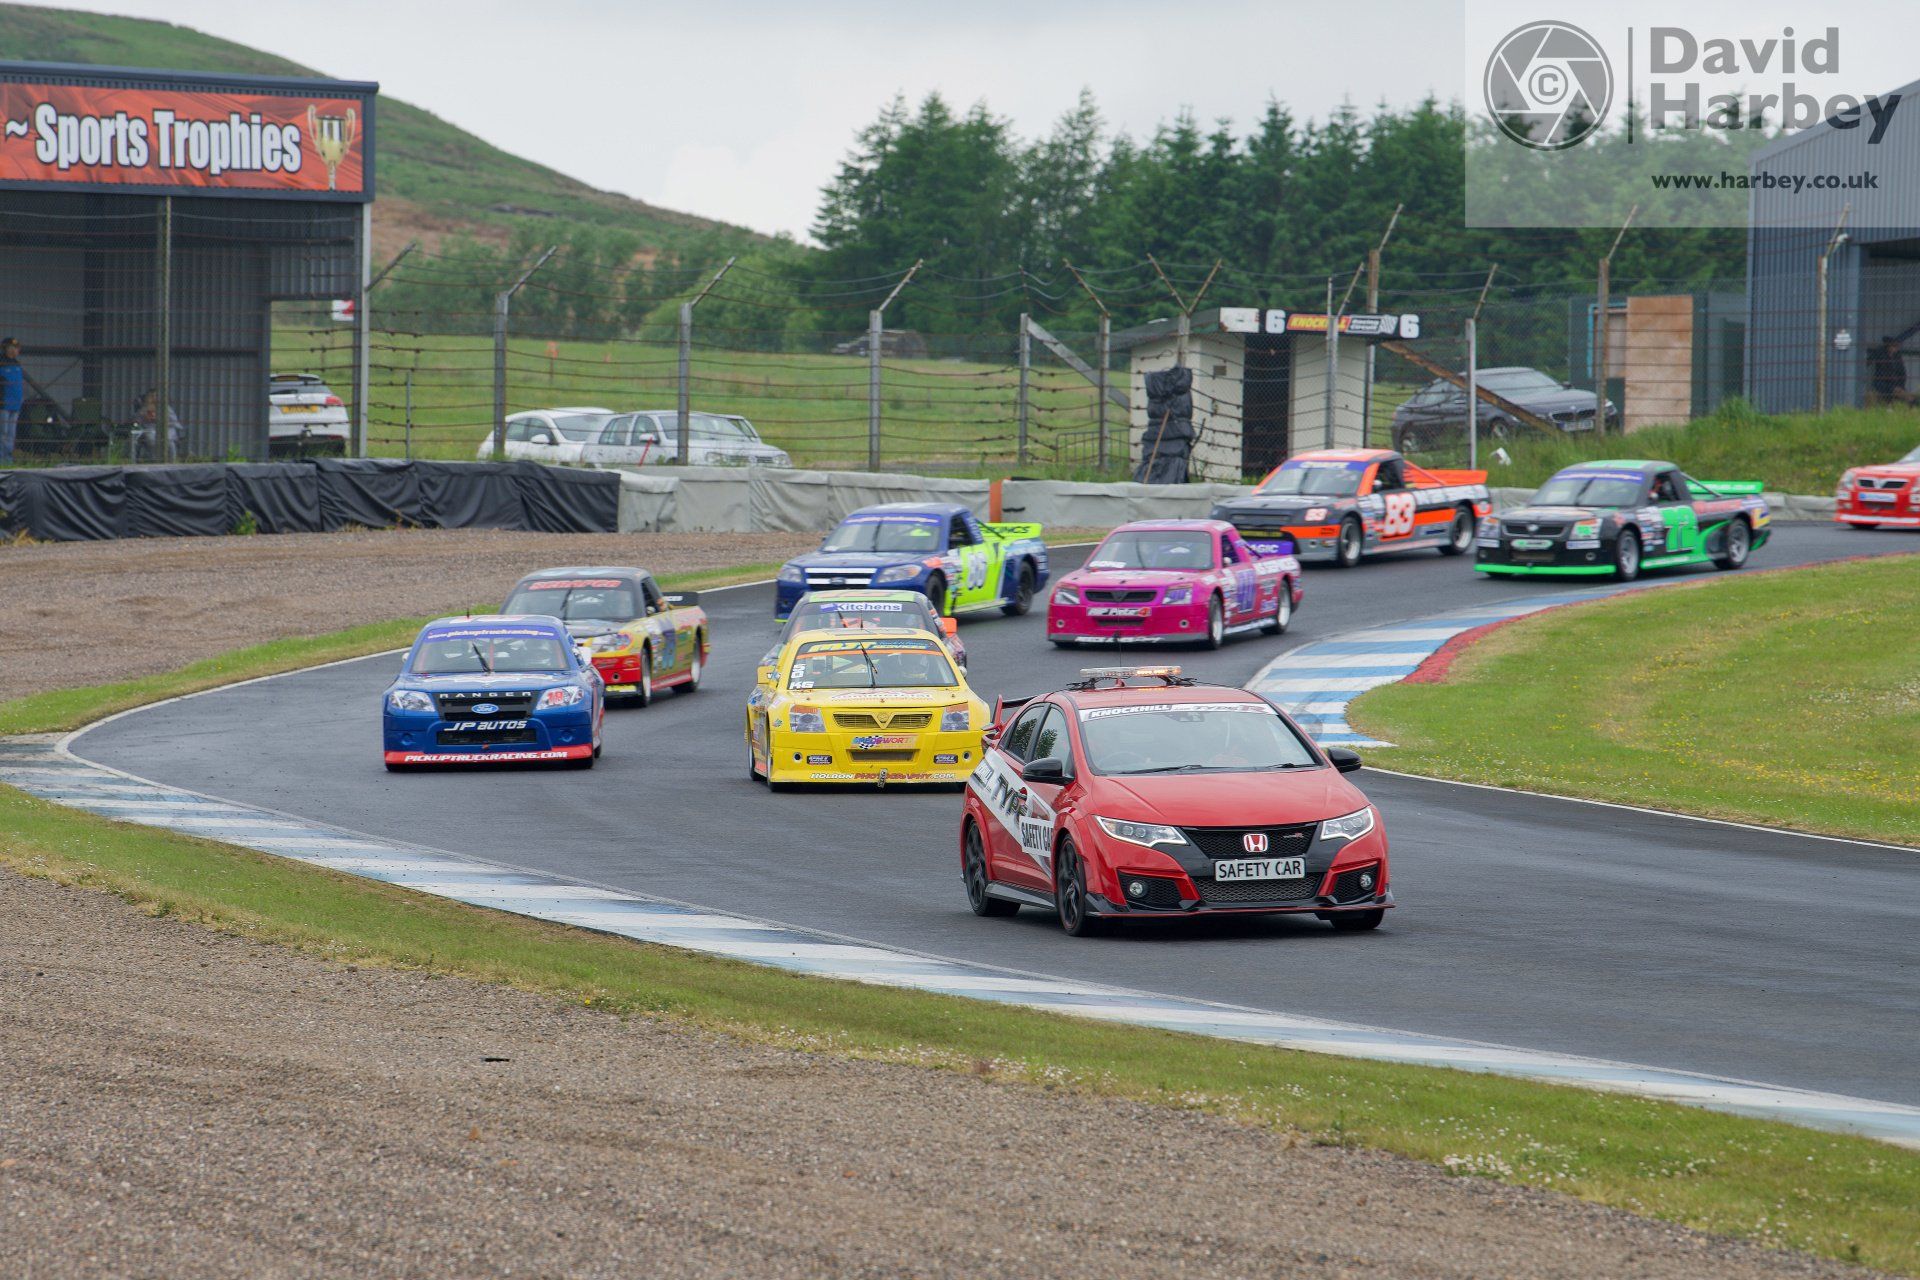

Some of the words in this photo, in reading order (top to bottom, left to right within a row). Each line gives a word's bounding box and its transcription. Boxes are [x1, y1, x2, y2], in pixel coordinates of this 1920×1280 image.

[34, 103, 149, 170] Sports
[153, 108, 302, 176] Trophies
[1266, 309, 1286, 334] 6
[1400, 314, 1419, 338] 6
[1384, 492, 1416, 536] 83
[837, 603, 901, 612] Kitchens
[789, 682, 814, 690] KG
[1091, 704, 1170, 718] KNOCKHILL
[444, 722, 477, 731] JP
[404, 751, 568, 762] PICKUPTRUCKRACING.COM
[1021, 822, 1043, 850] SAFETY
[1043, 825, 1054, 852] CA
[1219, 861, 1270, 879] SAFETY
[1275, 860, 1302, 876] CAR
